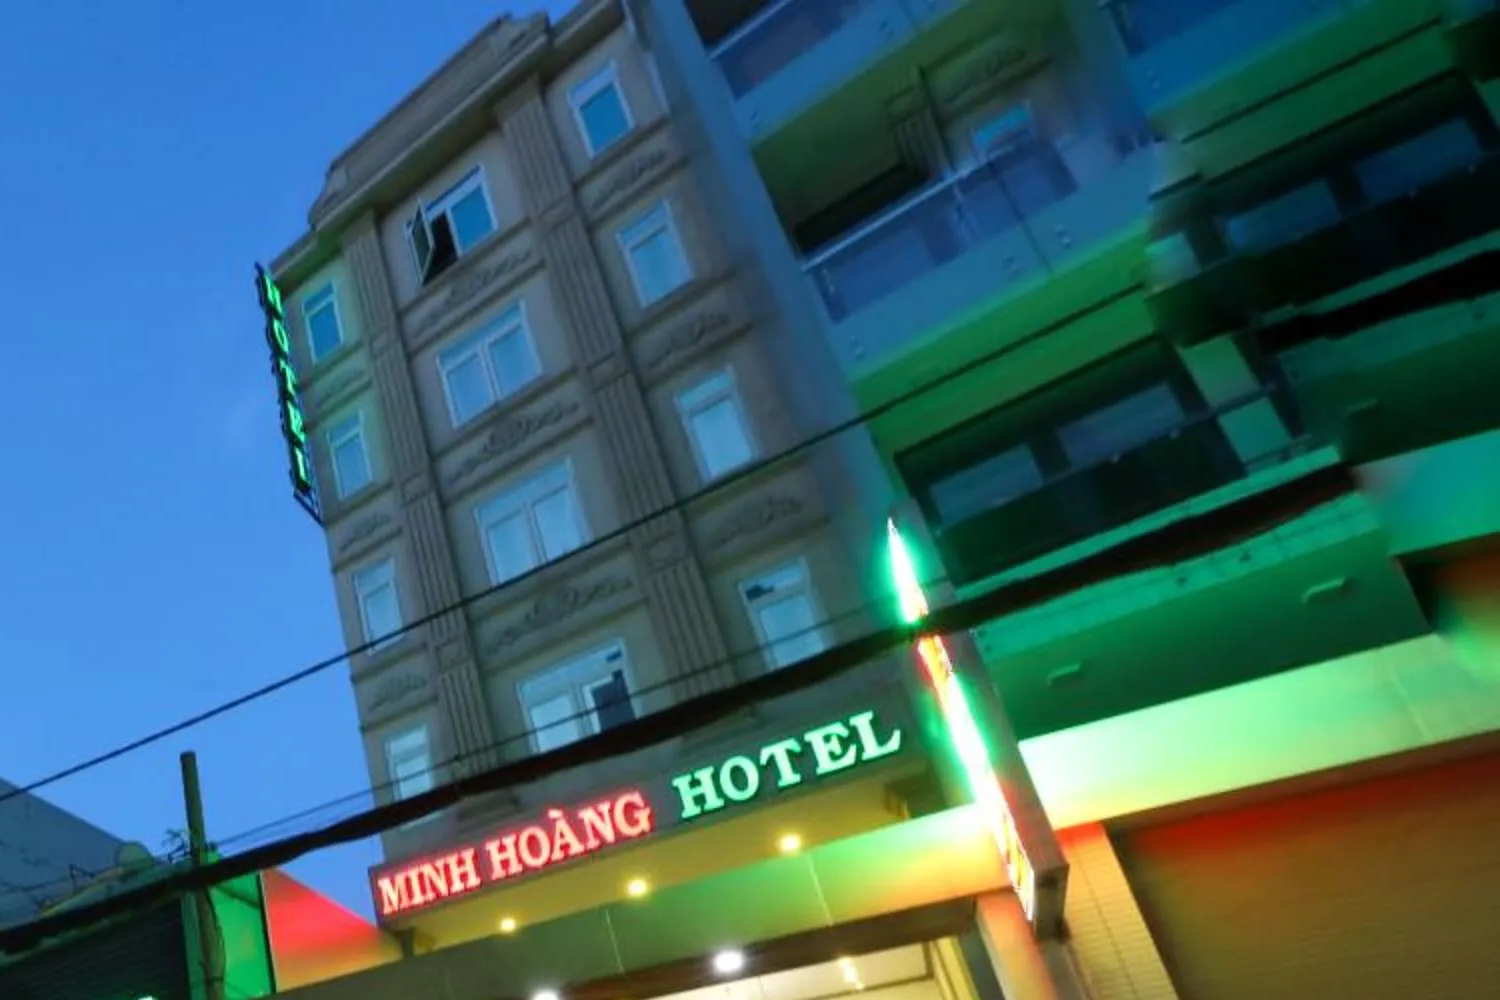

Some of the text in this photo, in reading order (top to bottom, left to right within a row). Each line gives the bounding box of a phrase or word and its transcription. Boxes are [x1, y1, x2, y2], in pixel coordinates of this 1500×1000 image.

[263, 272, 310, 487] HOTEL
[377, 710, 901, 915] MINH HOÀNG HOTEL
